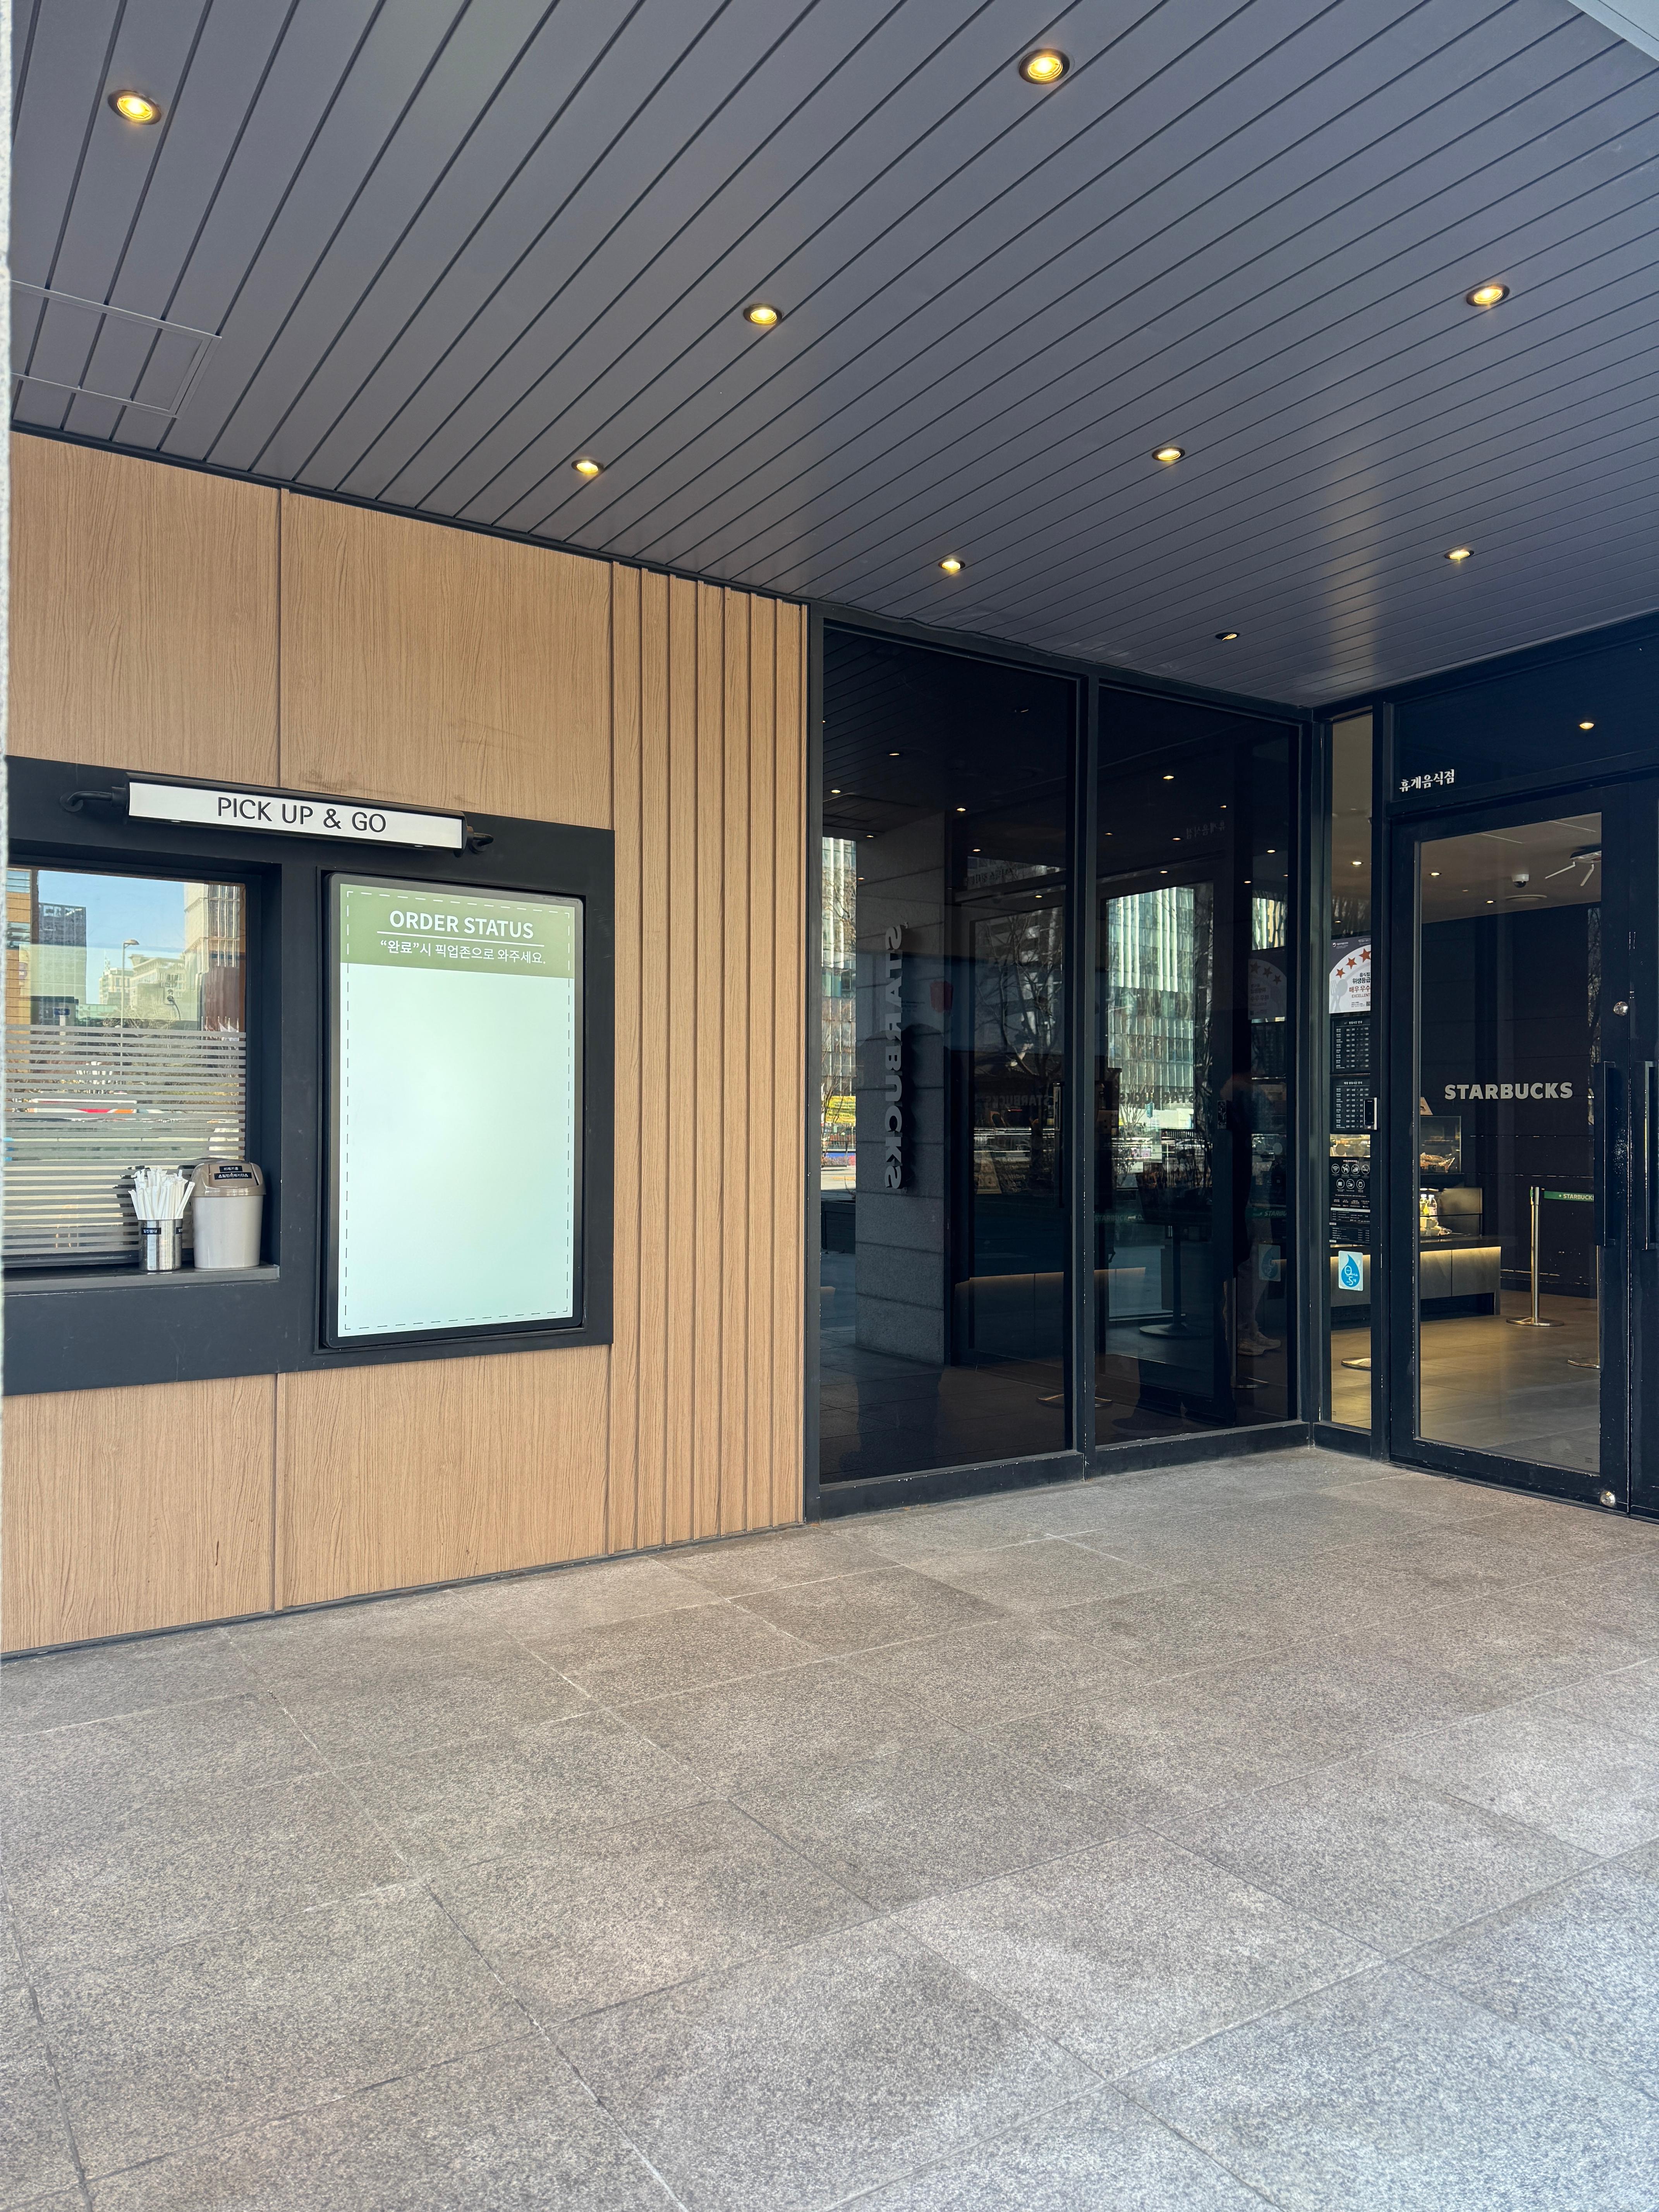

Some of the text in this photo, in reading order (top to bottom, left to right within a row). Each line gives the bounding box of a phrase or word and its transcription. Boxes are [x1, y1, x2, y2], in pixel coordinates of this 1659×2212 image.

[1399, 769, 1455, 792] 휴게음식점
[218, 797, 386, 833] PICK UP & GO
[390, 910, 534, 939] ORDER STATUS
[435, 944, 494, 959] 픽업존으로
[497, 949, 546, 964] 와주세요.
[1445, 1082, 1573, 1100] STARBUCKS
